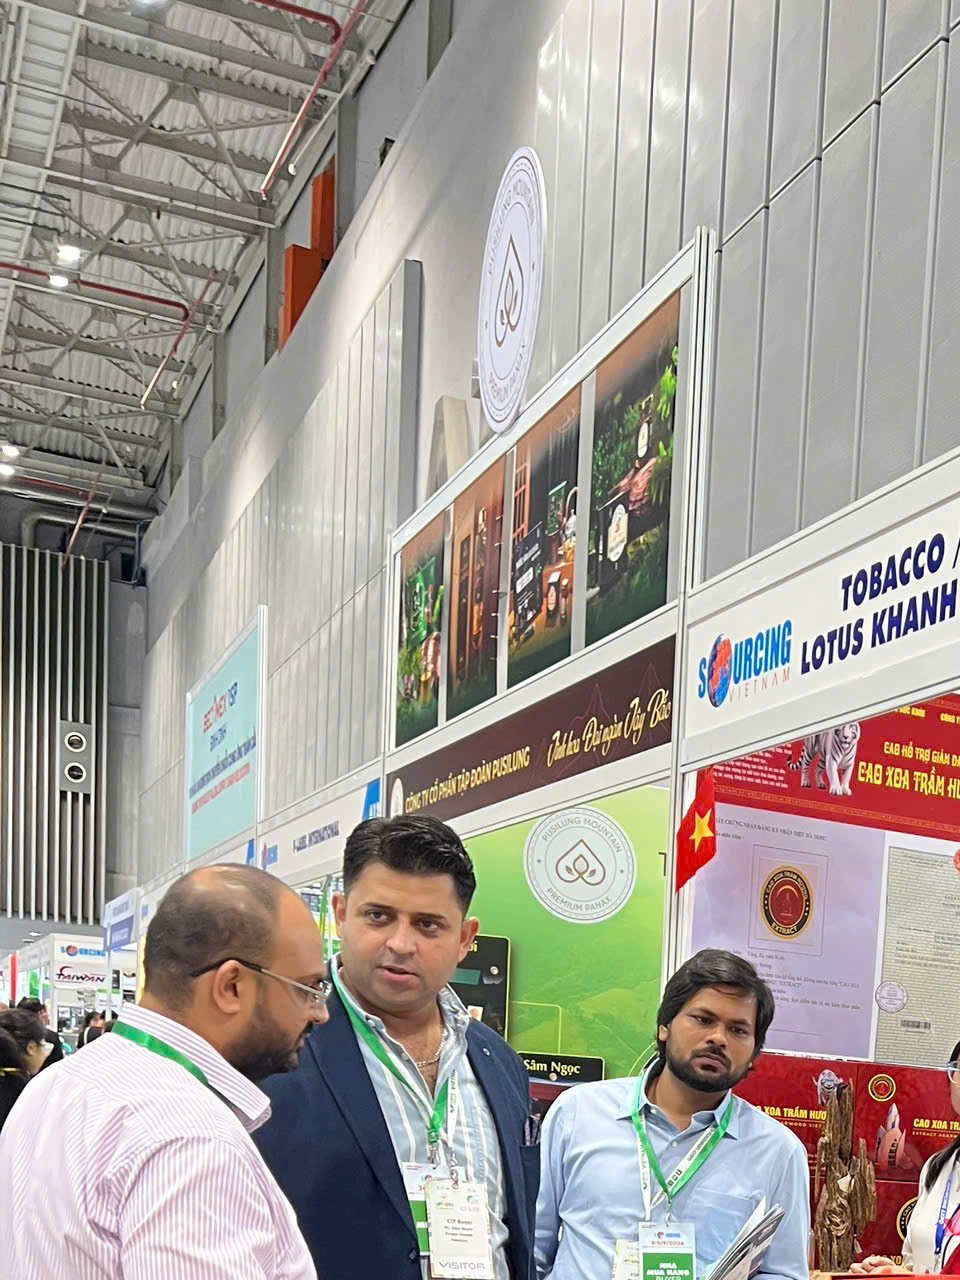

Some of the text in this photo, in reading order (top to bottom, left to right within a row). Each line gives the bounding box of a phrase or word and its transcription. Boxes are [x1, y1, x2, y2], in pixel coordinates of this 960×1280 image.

[841, 533, 945, 611] TOBACCO
[800, 618, 864, 675] LOTUS
[870, 578, 958, 649] KHANH
[729, 669, 791, 703] VIETNAM
[648, 688, 672, 728] Bắc
[492, 746, 531, 783] PUSILUNG
[858, 761, 883, 785] CAO
[885, 766, 911, 791] XOA
[542, 816, 623, 854] PUSILUNG MOUNTAIN
[546, 887, 613, 912] PREMIUM PANAX
[771, 921, 800, 935] EXTRACT
[56, 966, 105, 983] TAIWAN
[523, 1058, 581, 1077] Sâm Ngọc
[912, 1118, 948, 1131] CAO XOA
[439, 1261, 487, 1271] VISITOR
